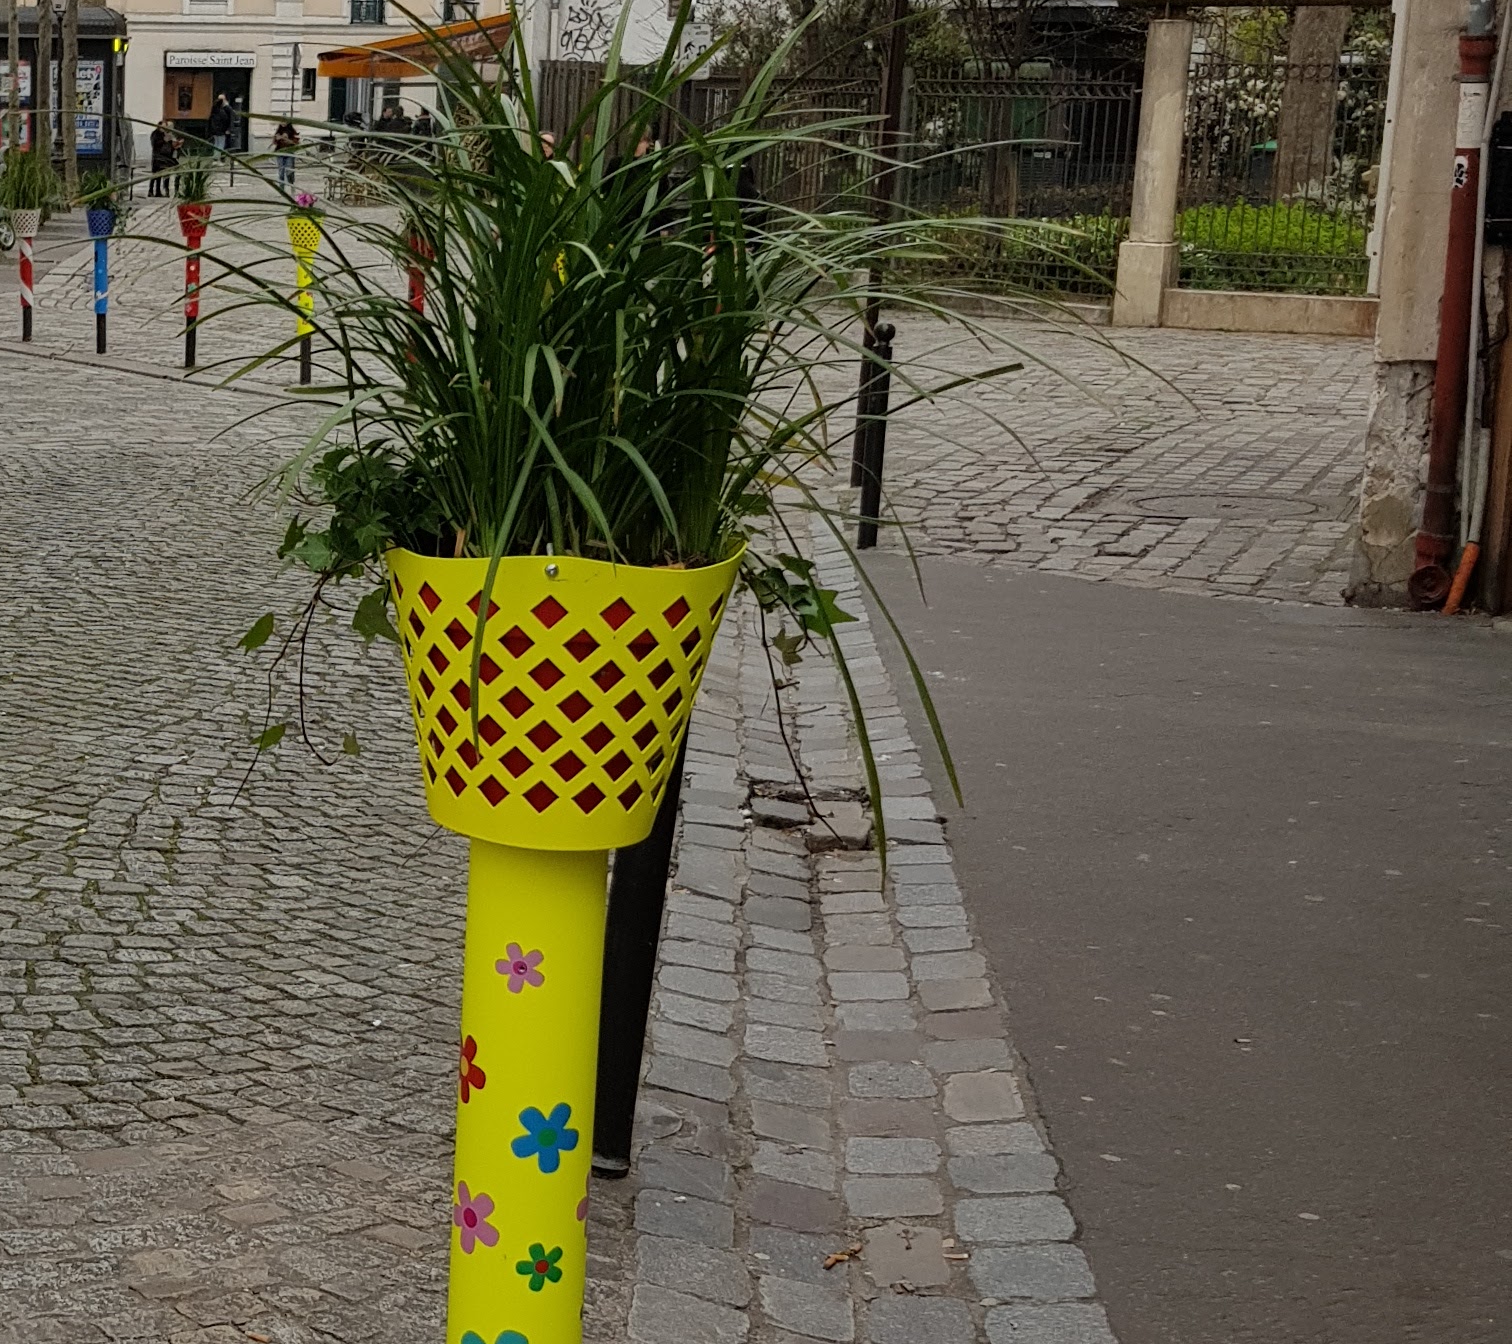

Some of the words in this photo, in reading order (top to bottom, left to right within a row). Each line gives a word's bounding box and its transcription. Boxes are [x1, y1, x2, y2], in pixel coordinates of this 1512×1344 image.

[169, 55, 207, 65] Paroisse
[209, 55, 232, 65] Saint
[234, 55, 255, 65] Jean
